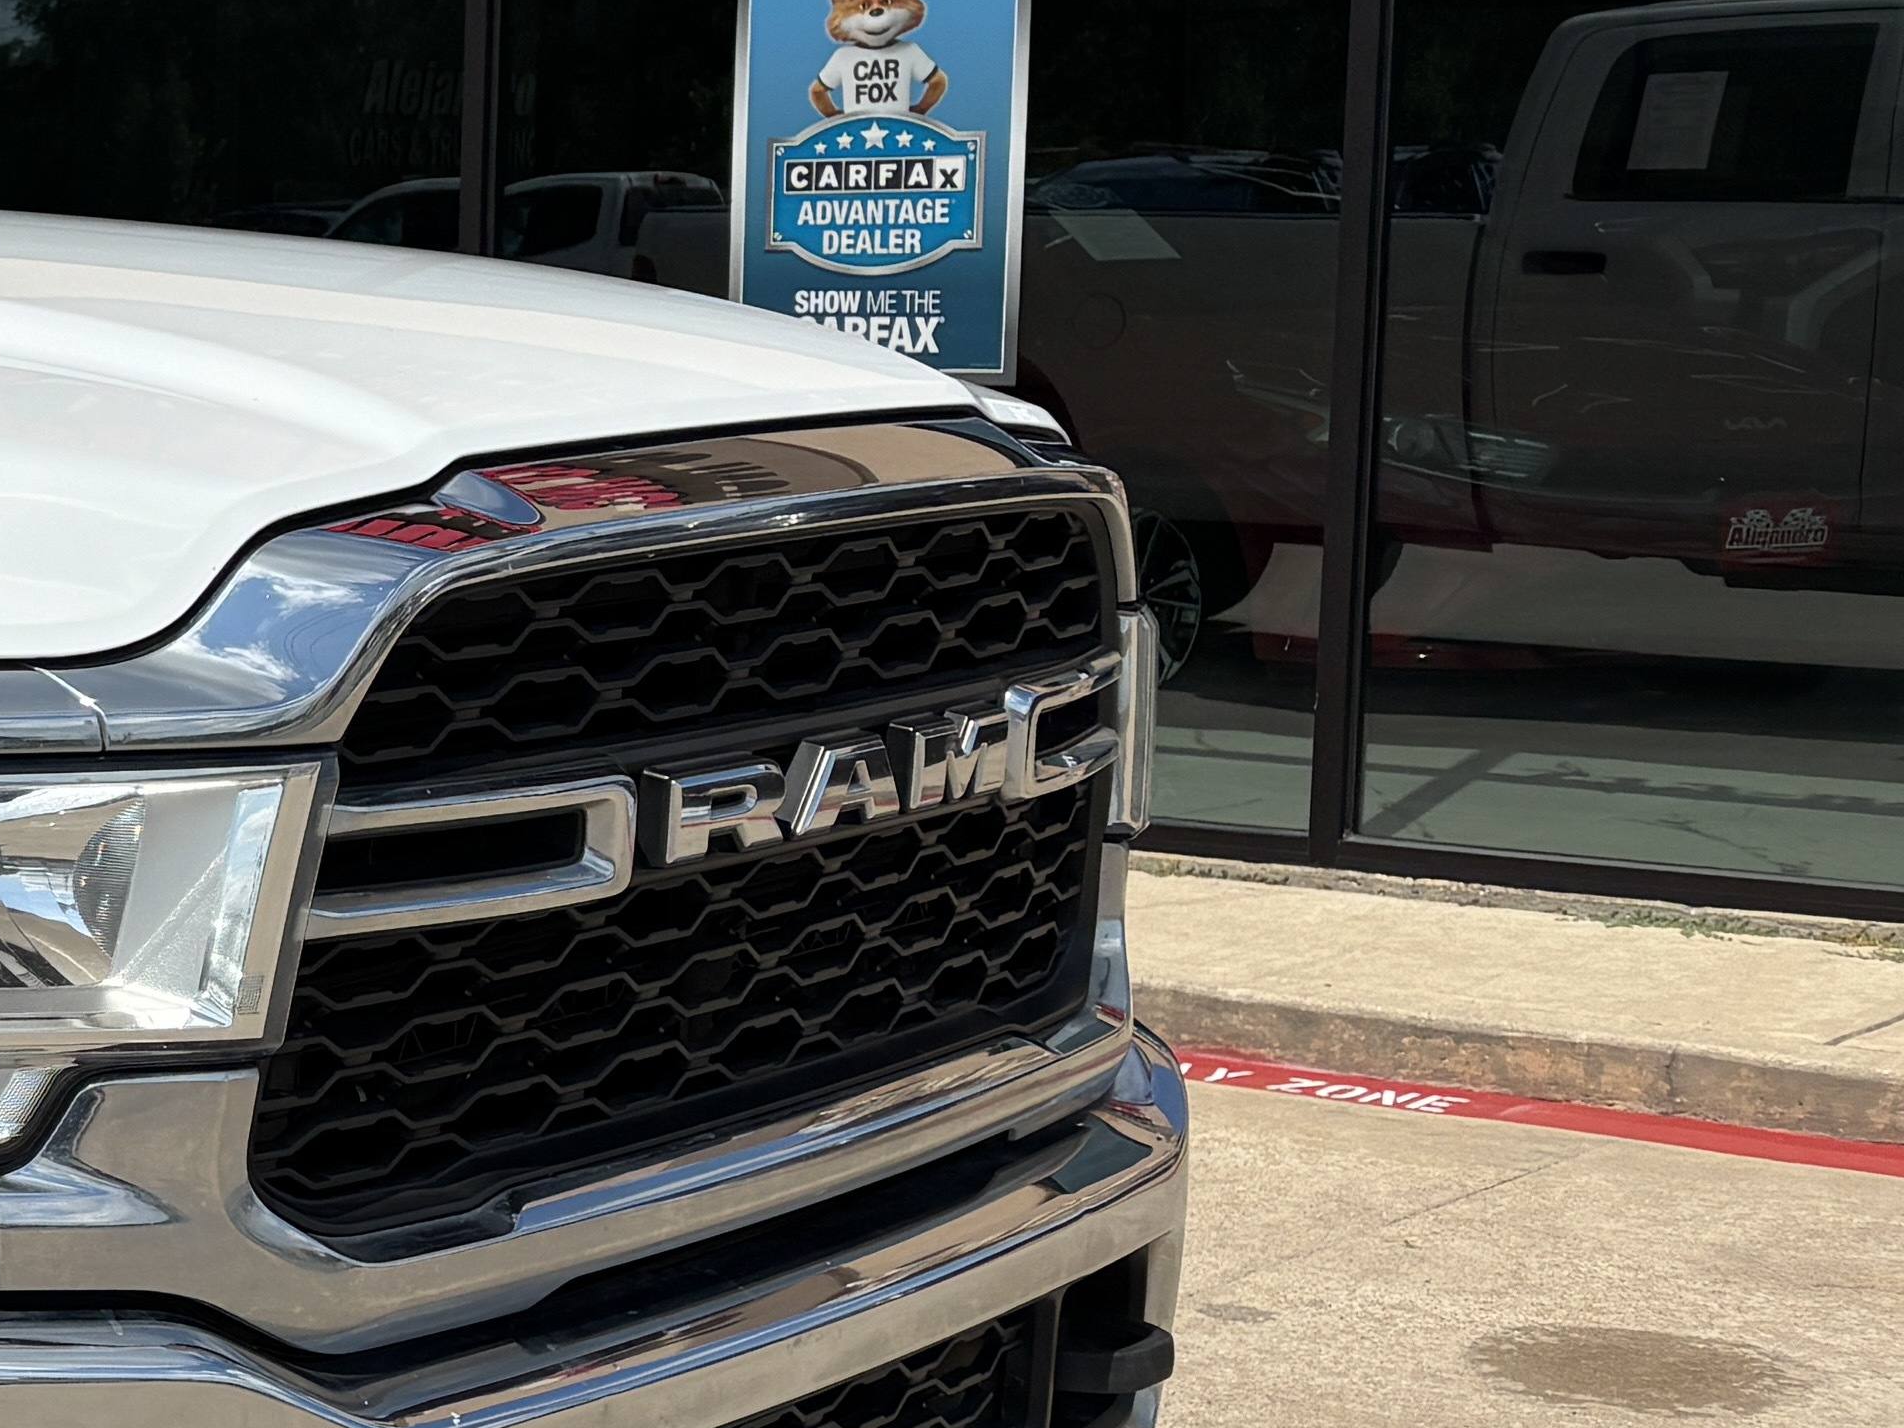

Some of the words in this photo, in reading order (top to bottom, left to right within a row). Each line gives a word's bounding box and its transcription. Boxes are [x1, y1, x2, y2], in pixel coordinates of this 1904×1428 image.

[853, 59, 900, 82] CAR
[854, 81, 898, 104] FOX
[788, 159, 961, 190] CARFAX
[796, 198, 950, 226] ADVANTAGE
[821, 228, 922, 255] DEALER
[794, 289, 860, 314] SHOW
[866, 290, 897, 314] ME
[901, 289, 942, 314] THE
[644, 700, 1010, 868] RAM
[1265, 1076, 1471, 1114] ZONE
